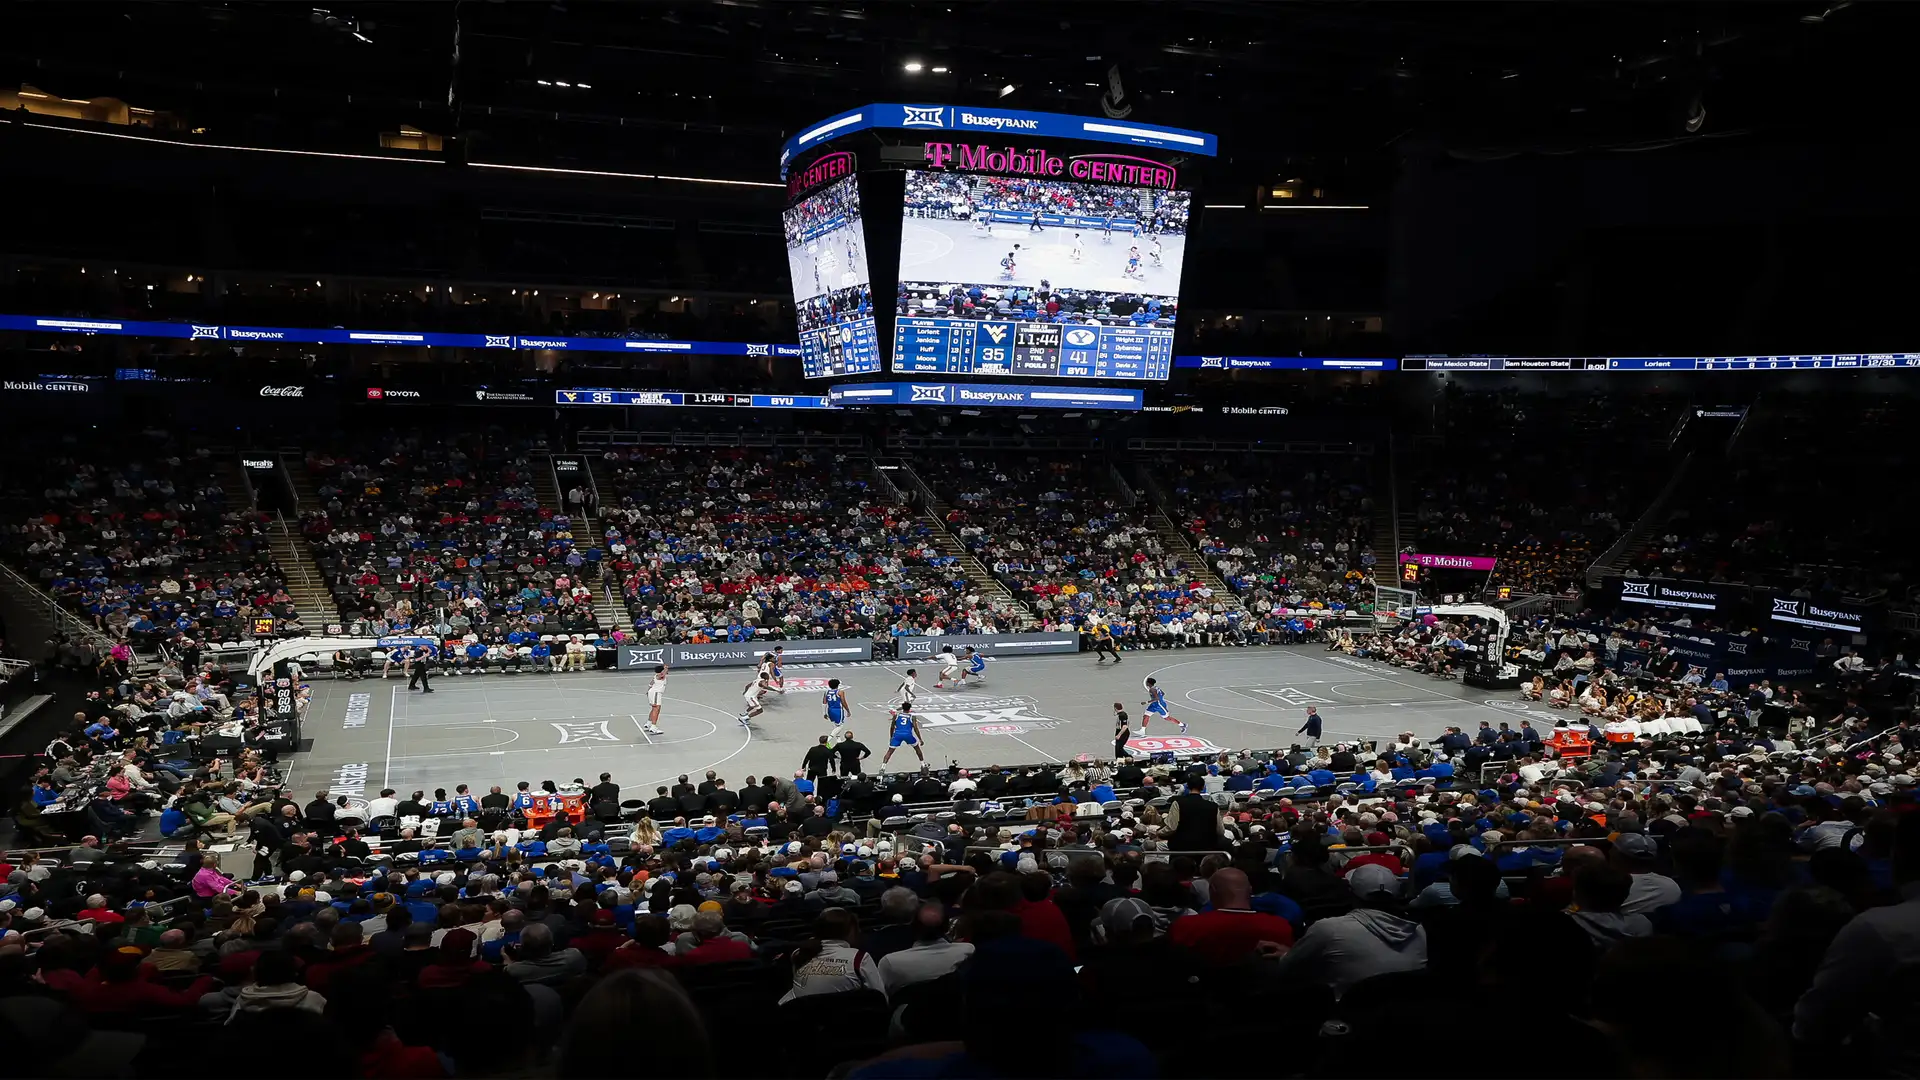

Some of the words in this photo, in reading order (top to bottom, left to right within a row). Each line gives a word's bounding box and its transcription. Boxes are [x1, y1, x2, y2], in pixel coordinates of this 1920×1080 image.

[956, 143, 1064, 176] Mobile
[1072, 159, 1171, 187] CENTER
[803, 157, 847, 189] CENTER
[1017, 334, 1059, 346] 11:44
[983, 347, 1005, 361] 35
[1070, 351, 1088, 364] 41
[1067, 367, 1088, 375] BYU
[3, 380, 44, 391] Mobile
[45, 383, 87, 392] CENTER
[384, 389, 421, 397] TOYOTA
[592, 392, 612, 403] 35
[695, 394, 725, 403] 11:44
[771, 397, 794, 405] BYU
[1231, 406, 1257, 414] Mobile
[1434, 556, 1473, 567] Mobile
[1404, 570, 1417, 580] 24
[255, 625, 269, 633] 24
[680, 651, 748, 663] BuseyBANK
[277, 689, 290, 698] GO
[827, 694, 837, 702] 34
[278, 697, 290, 706] GO
[278, 705, 290, 713] GO
[900, 717, 907, 726] 3
[329, 761, 369, 797] Allstate
[460, 799, 469, 810] 5
[522, 796, 530, 806] 6
